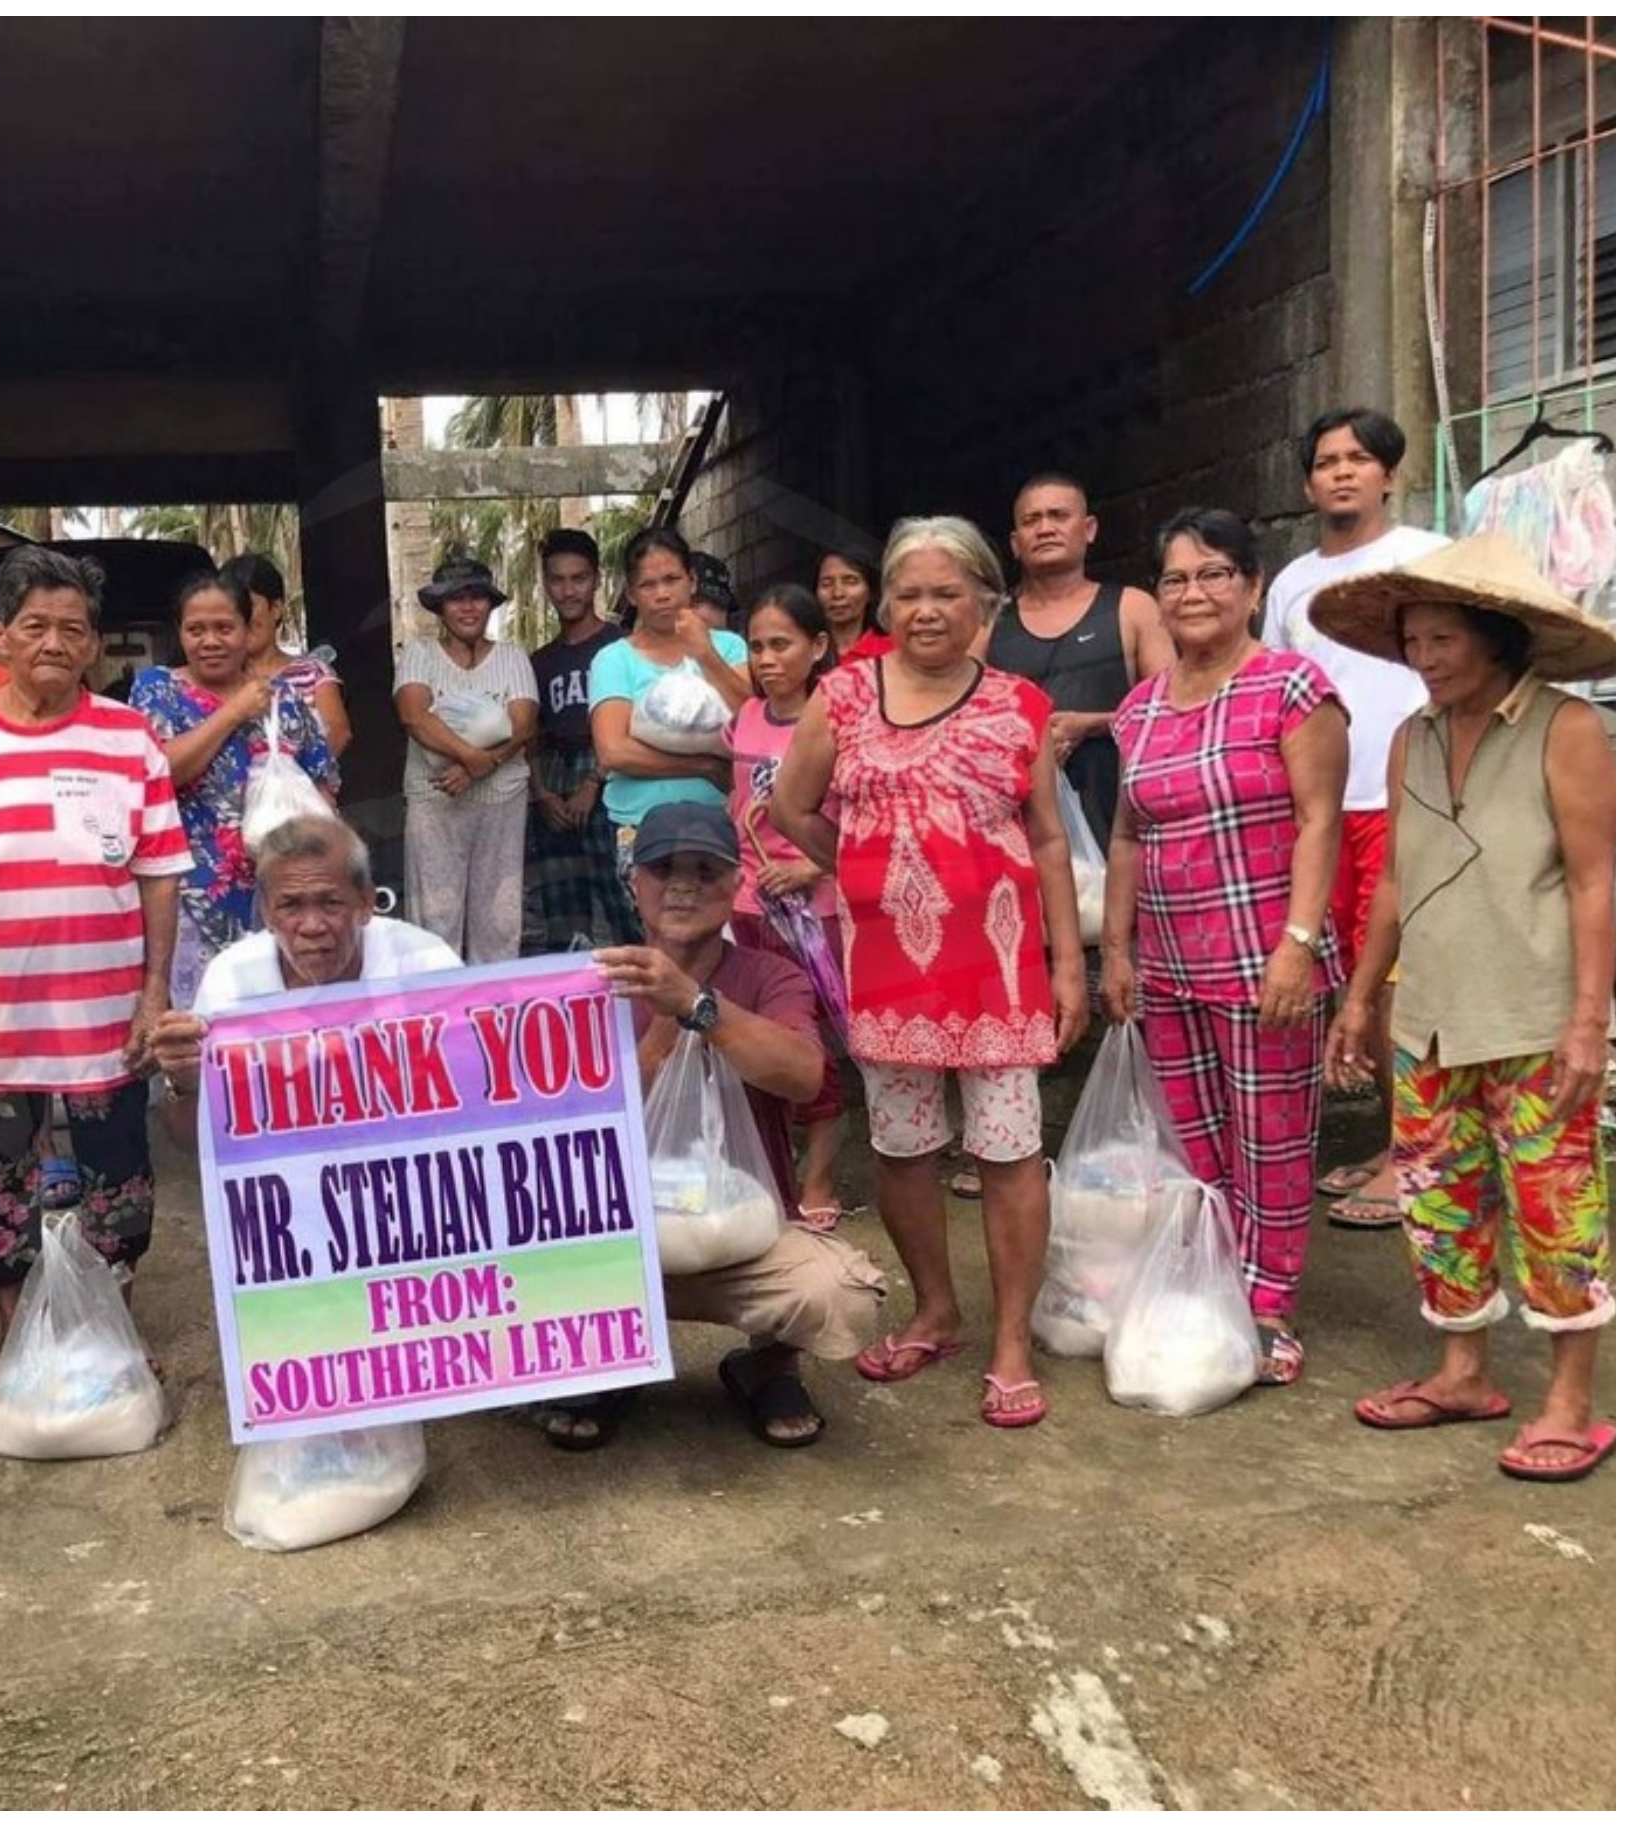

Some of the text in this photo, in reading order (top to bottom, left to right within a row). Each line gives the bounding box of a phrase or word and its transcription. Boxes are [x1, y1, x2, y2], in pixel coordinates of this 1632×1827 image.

[216, 994, 613, 1137] THANK YOU
[224, 1127, 634, 1285] MR. STELIAN BALTA
[249, 1306, 647, 1416] SOUTHERN LEYTE
[367, 1263, 517, 1334] FROM:
